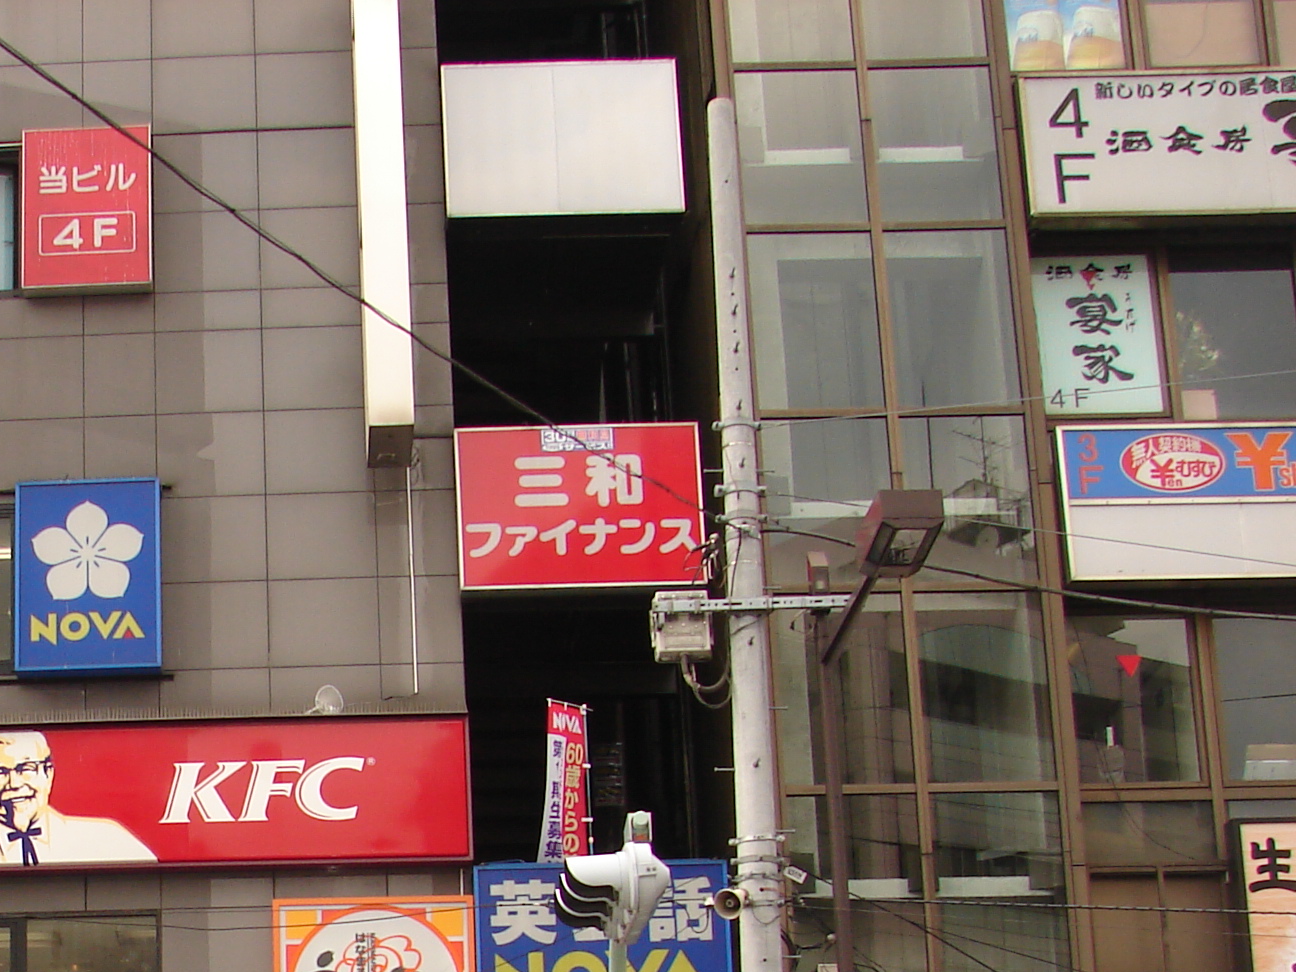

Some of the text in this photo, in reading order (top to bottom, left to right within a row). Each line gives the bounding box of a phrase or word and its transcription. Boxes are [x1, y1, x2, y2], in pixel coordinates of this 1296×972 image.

[39, 162, 136, 196] 当ビル
[52, 215, 119, 250] 4F
[1050, 387, 1090, 409] 4F
[514, 453, 644, 507] 三和
[466, 518, 698, 558] ファイナンス
[30, 609, 146, 647] NOVA
[159, 756, 366, 824] KFC
[563, 742, 584, 857] 60歳からの
[489, 877, 714, 946] 英話
